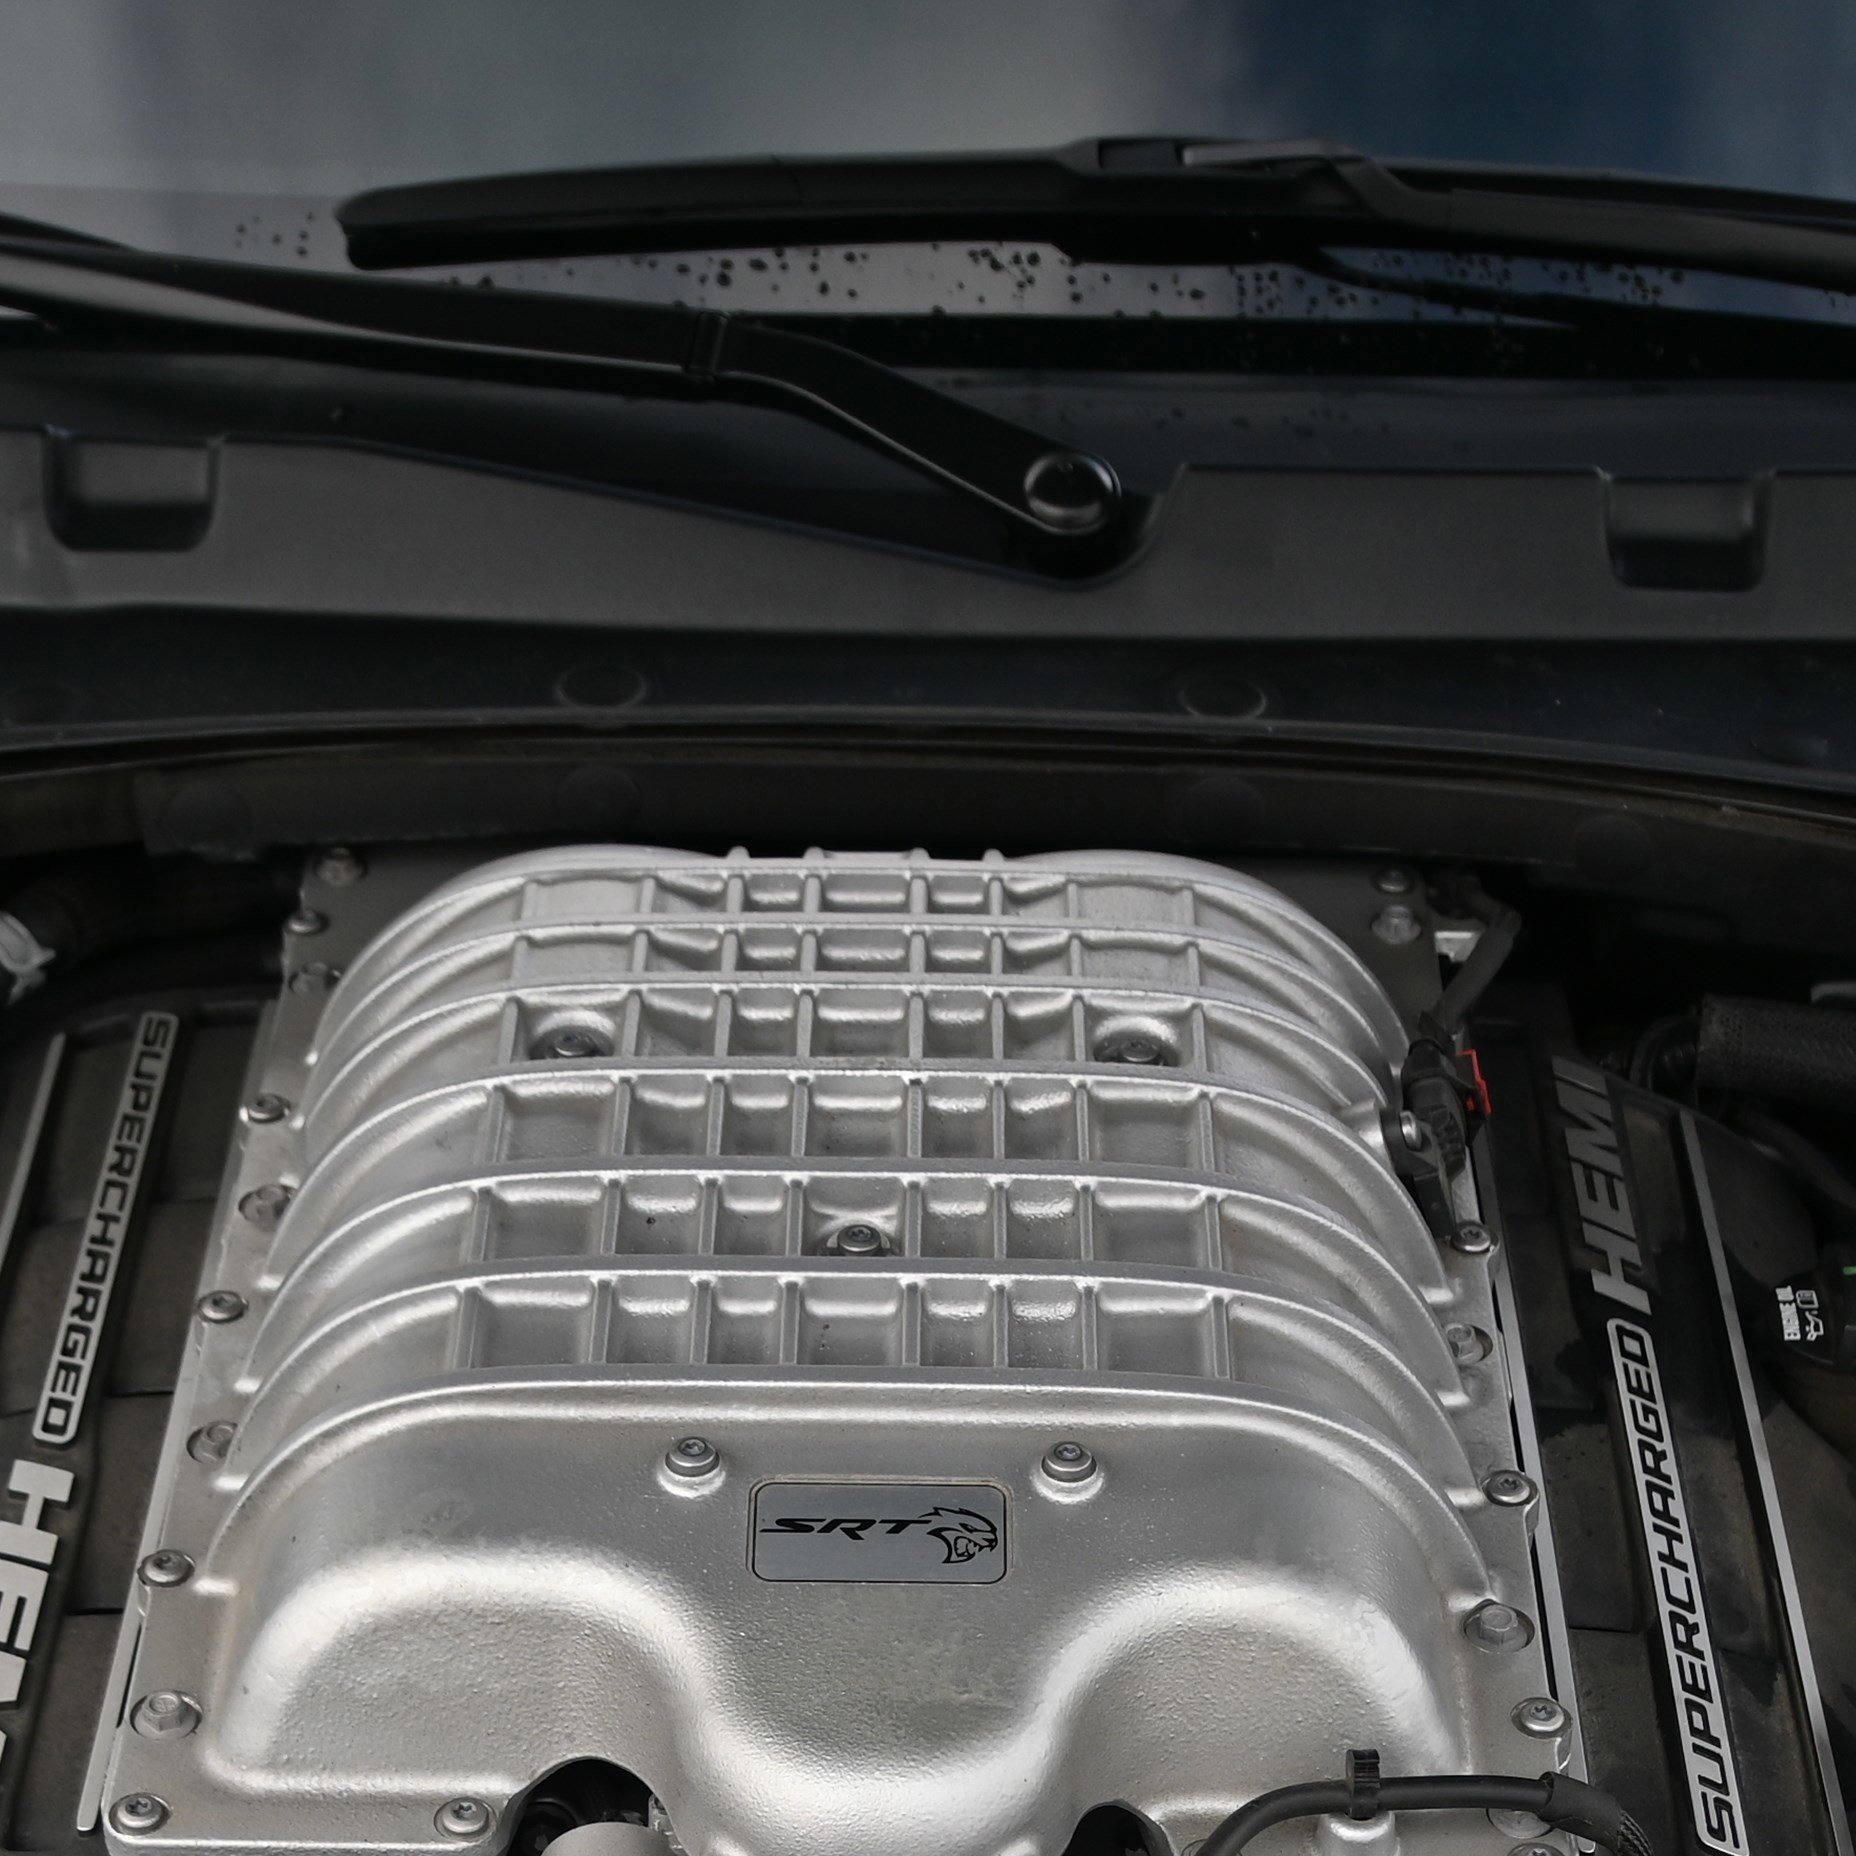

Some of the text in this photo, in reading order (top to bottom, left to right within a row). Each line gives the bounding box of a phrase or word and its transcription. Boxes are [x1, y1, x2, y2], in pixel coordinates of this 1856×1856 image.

[38, 1014, 172, 1440] SUPERCHARGED
[759, 1517, 931, 1541] SRT
[1554, 1060, 1748, 1853] SUPERCHARGED HEMI
